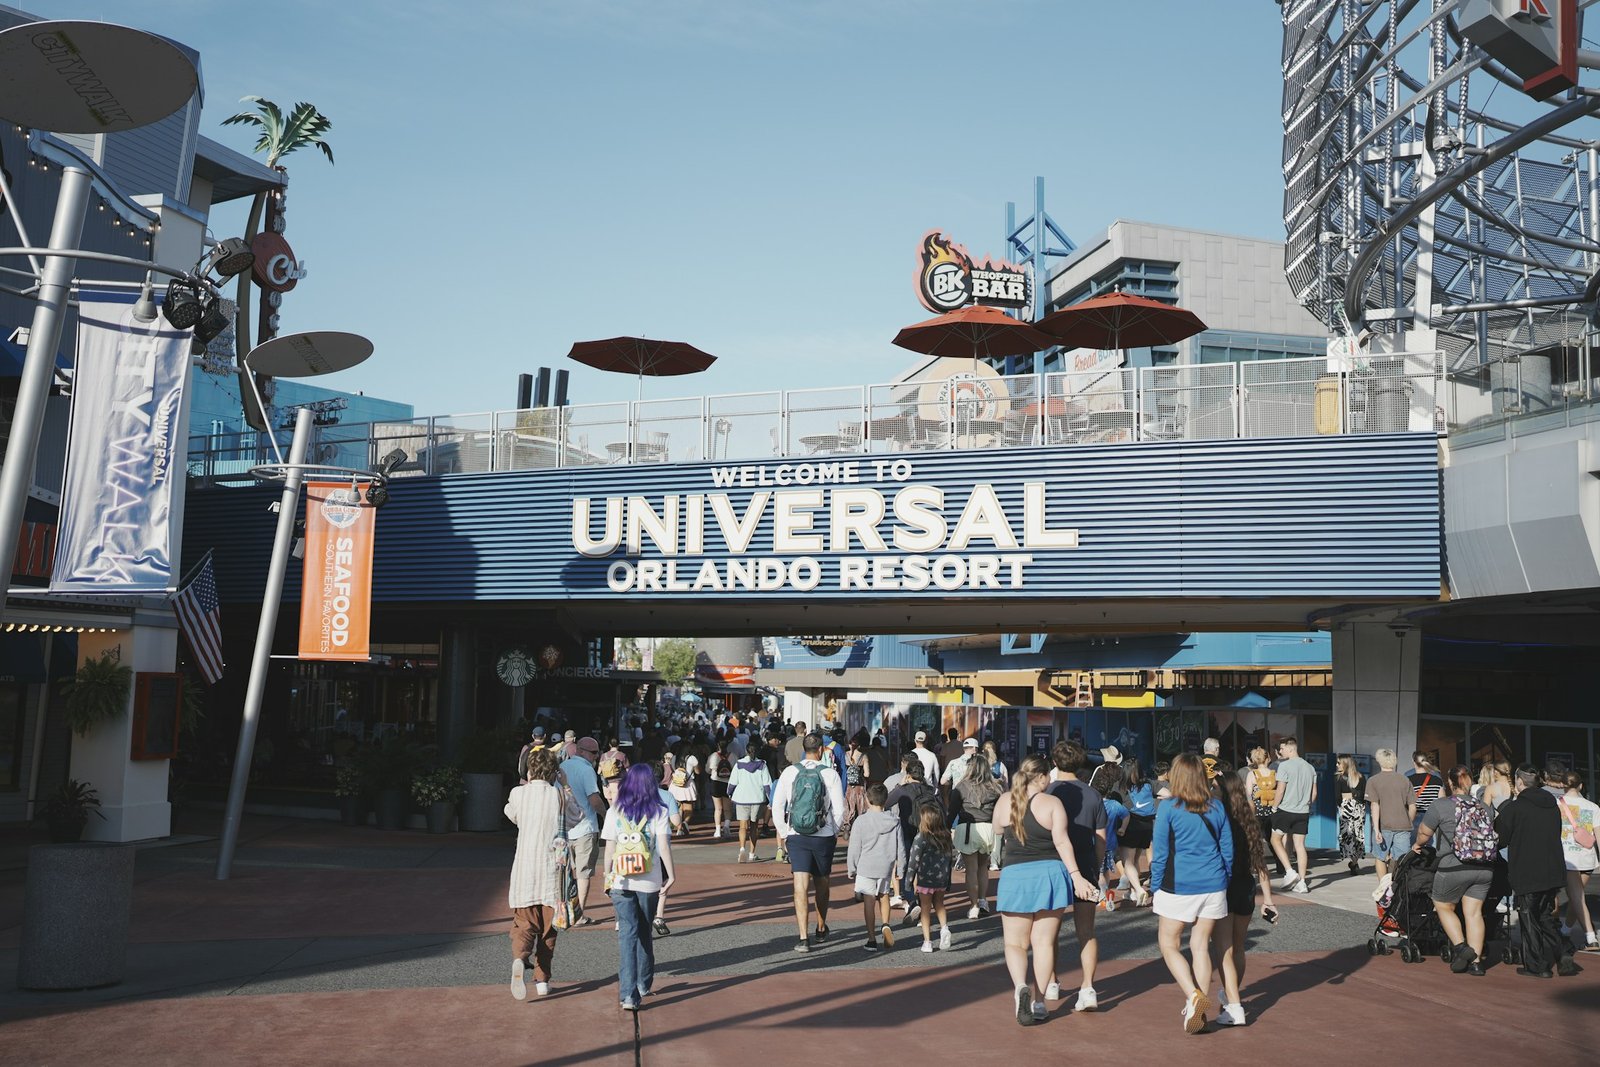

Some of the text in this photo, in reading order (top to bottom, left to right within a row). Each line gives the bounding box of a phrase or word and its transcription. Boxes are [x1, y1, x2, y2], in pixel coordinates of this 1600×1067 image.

[31, 32, 135, 123] CITYWALK
[266, 254, 308, 285] Club
[933, 269, 965, 296] BK
[970, 270, 1025, 282] WHOPPER
[971, 279, 1026, 300] BAR
[152, 406, 171, 485] UNIVERSAL
[710, 458, 913, 488] WELCOME TO
[571, 481, 1080, 558] UNIVERSAL
[331, 536, 353, 647] SEAFOOD
[606, 553, 1034, 593] ORLANDO RESORT
[320, 543, 335, 653] SOUTHERN FAVORITES
